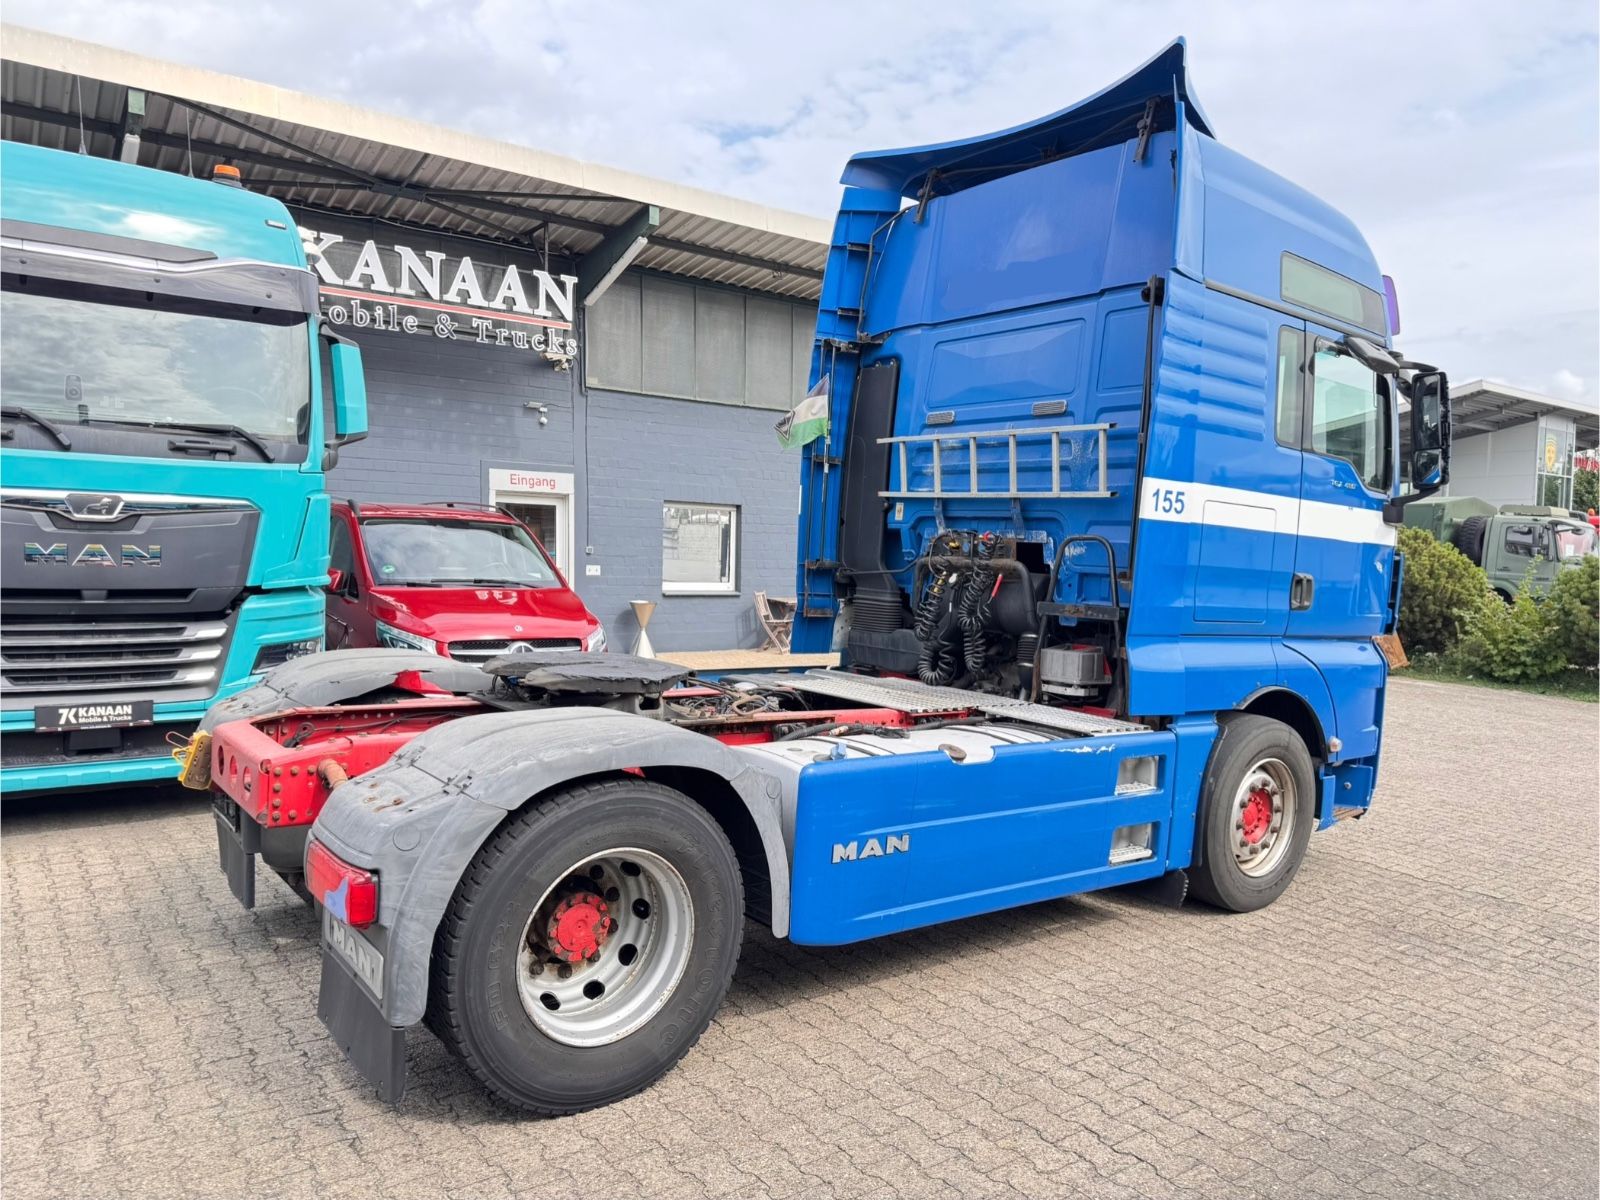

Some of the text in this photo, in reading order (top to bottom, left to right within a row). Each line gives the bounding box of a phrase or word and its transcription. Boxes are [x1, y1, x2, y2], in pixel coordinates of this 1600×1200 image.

[297, 226, 578, 321] KANAAN
[319, 297, 577, 355] obile & Trucks
[509, 473, 556, 489] Eingang
[1151, 488, 1185, 514] 155
[24, 542, 161, 567] MAN
[79, 705, 132, 716] KANAAN
[831, 833, 910, 864] MAN
[332, 918, 371, 980] MAN
